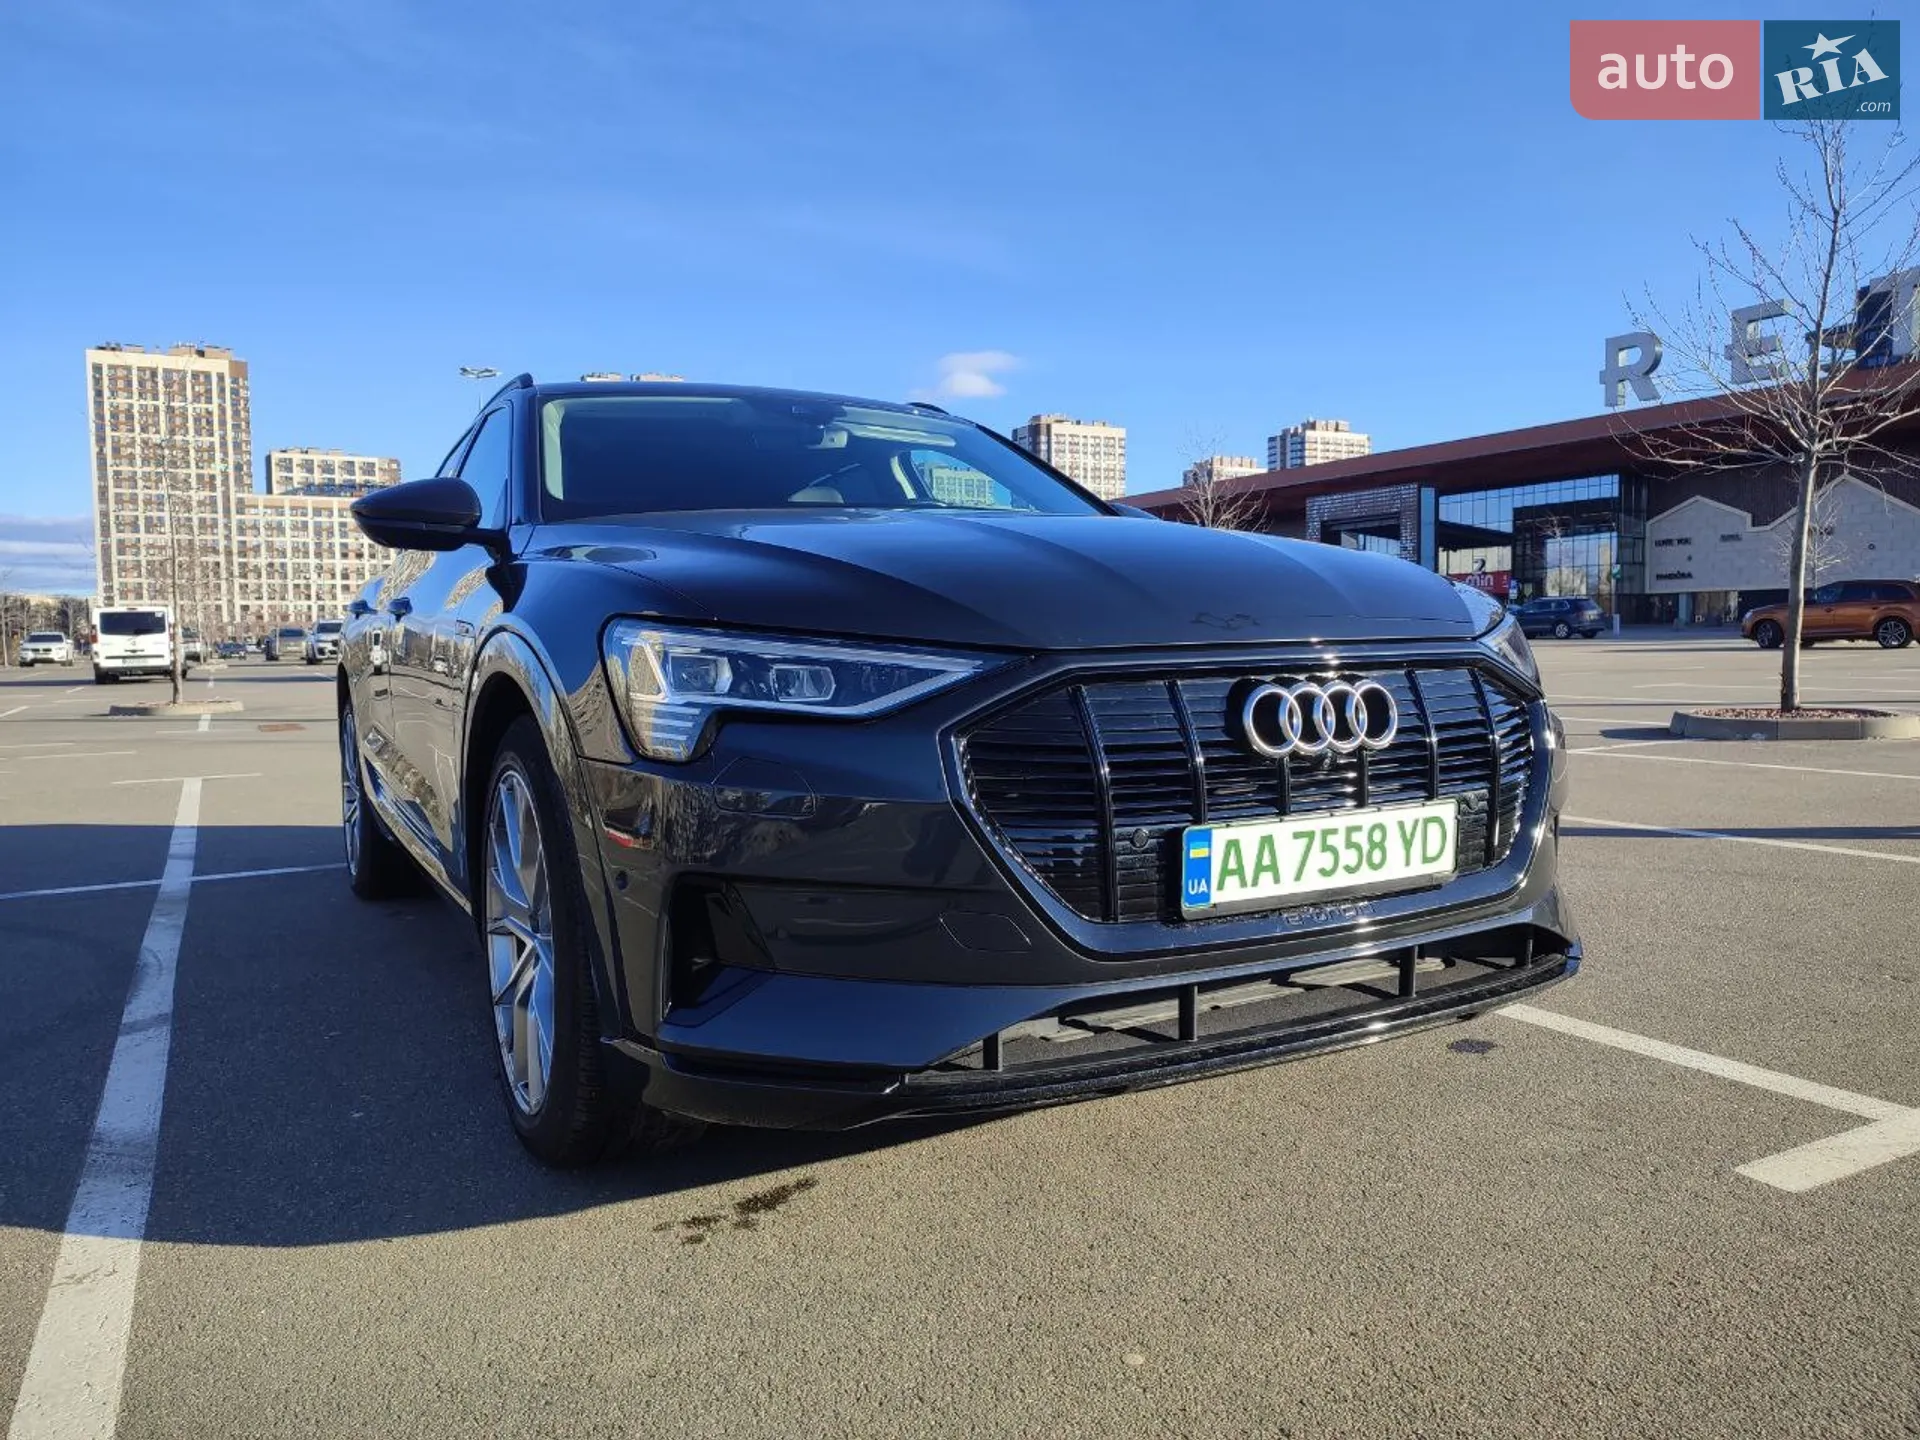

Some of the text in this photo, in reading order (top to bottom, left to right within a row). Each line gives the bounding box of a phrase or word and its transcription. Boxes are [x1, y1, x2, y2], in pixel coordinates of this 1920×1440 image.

[1216, 815, 1447, 891] AA 7558 YD
[1187, 879, 1208, 896] UA
